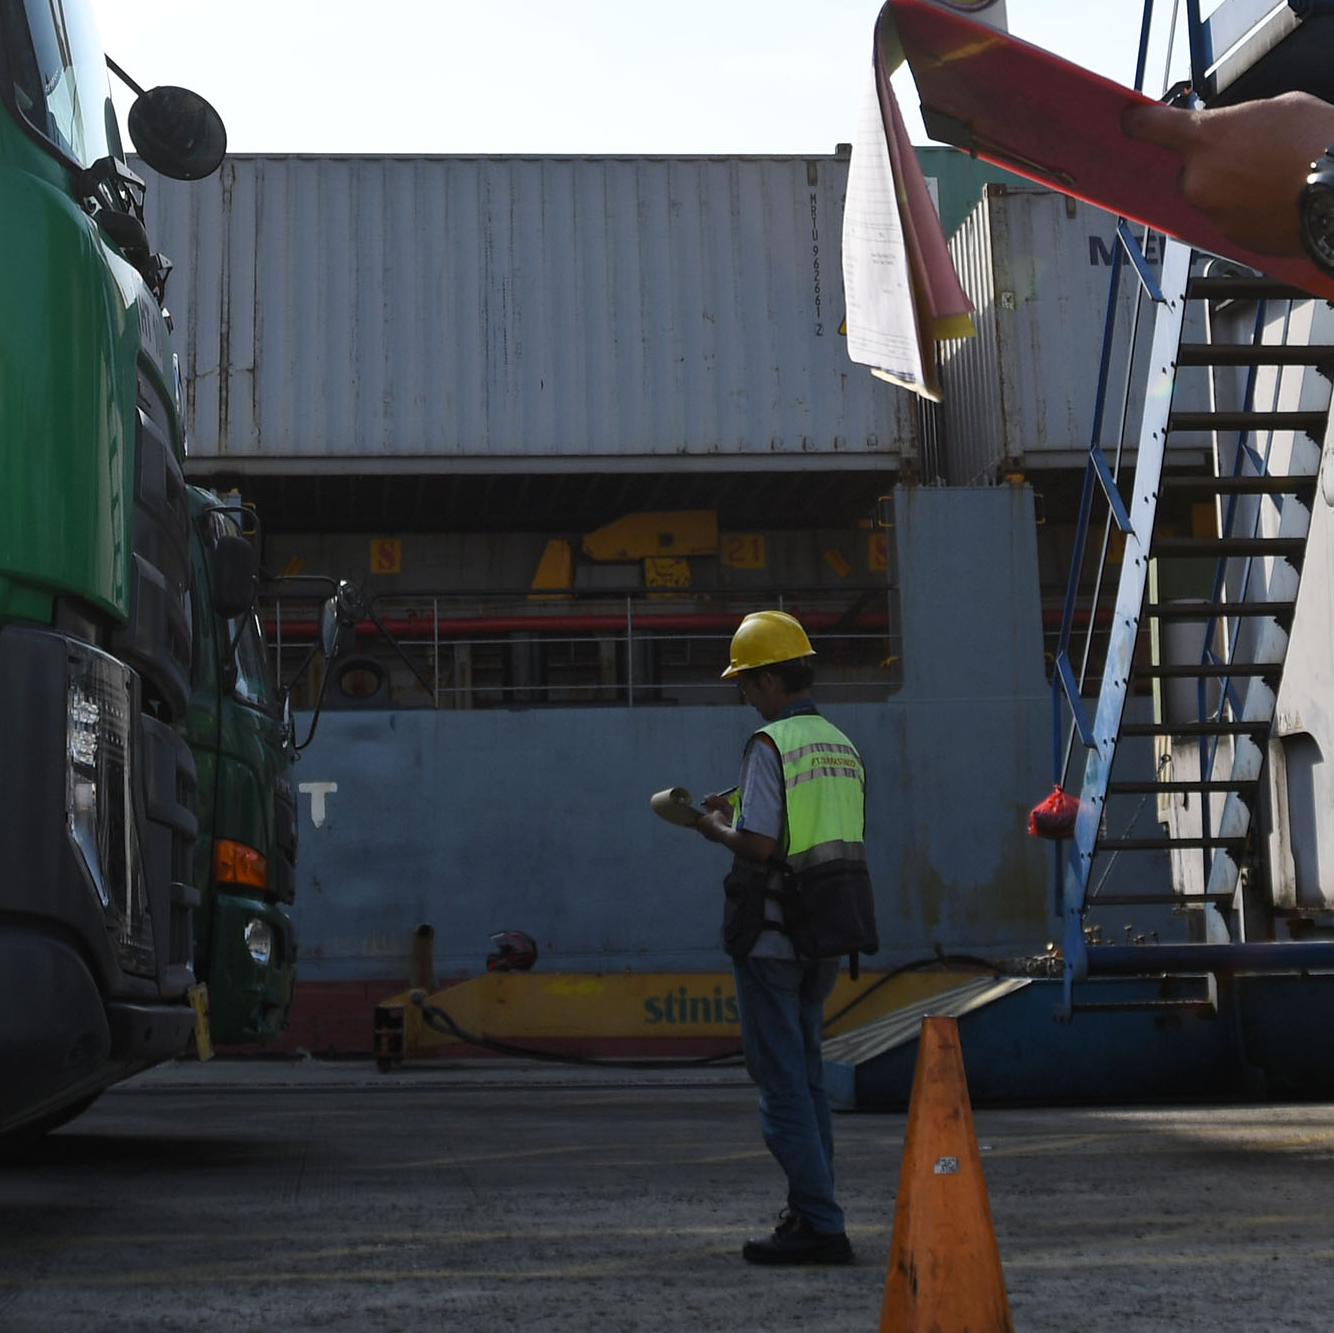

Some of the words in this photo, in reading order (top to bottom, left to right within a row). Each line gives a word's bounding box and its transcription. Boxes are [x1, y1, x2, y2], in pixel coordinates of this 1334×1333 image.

[810, 193, 819, 242] MRTU
[813, 245, 821, 319] 962661
[377, 539, 396, 570] S
[727, 537, 761, 564] 21
[643, 985, 741, 1024] stinis
